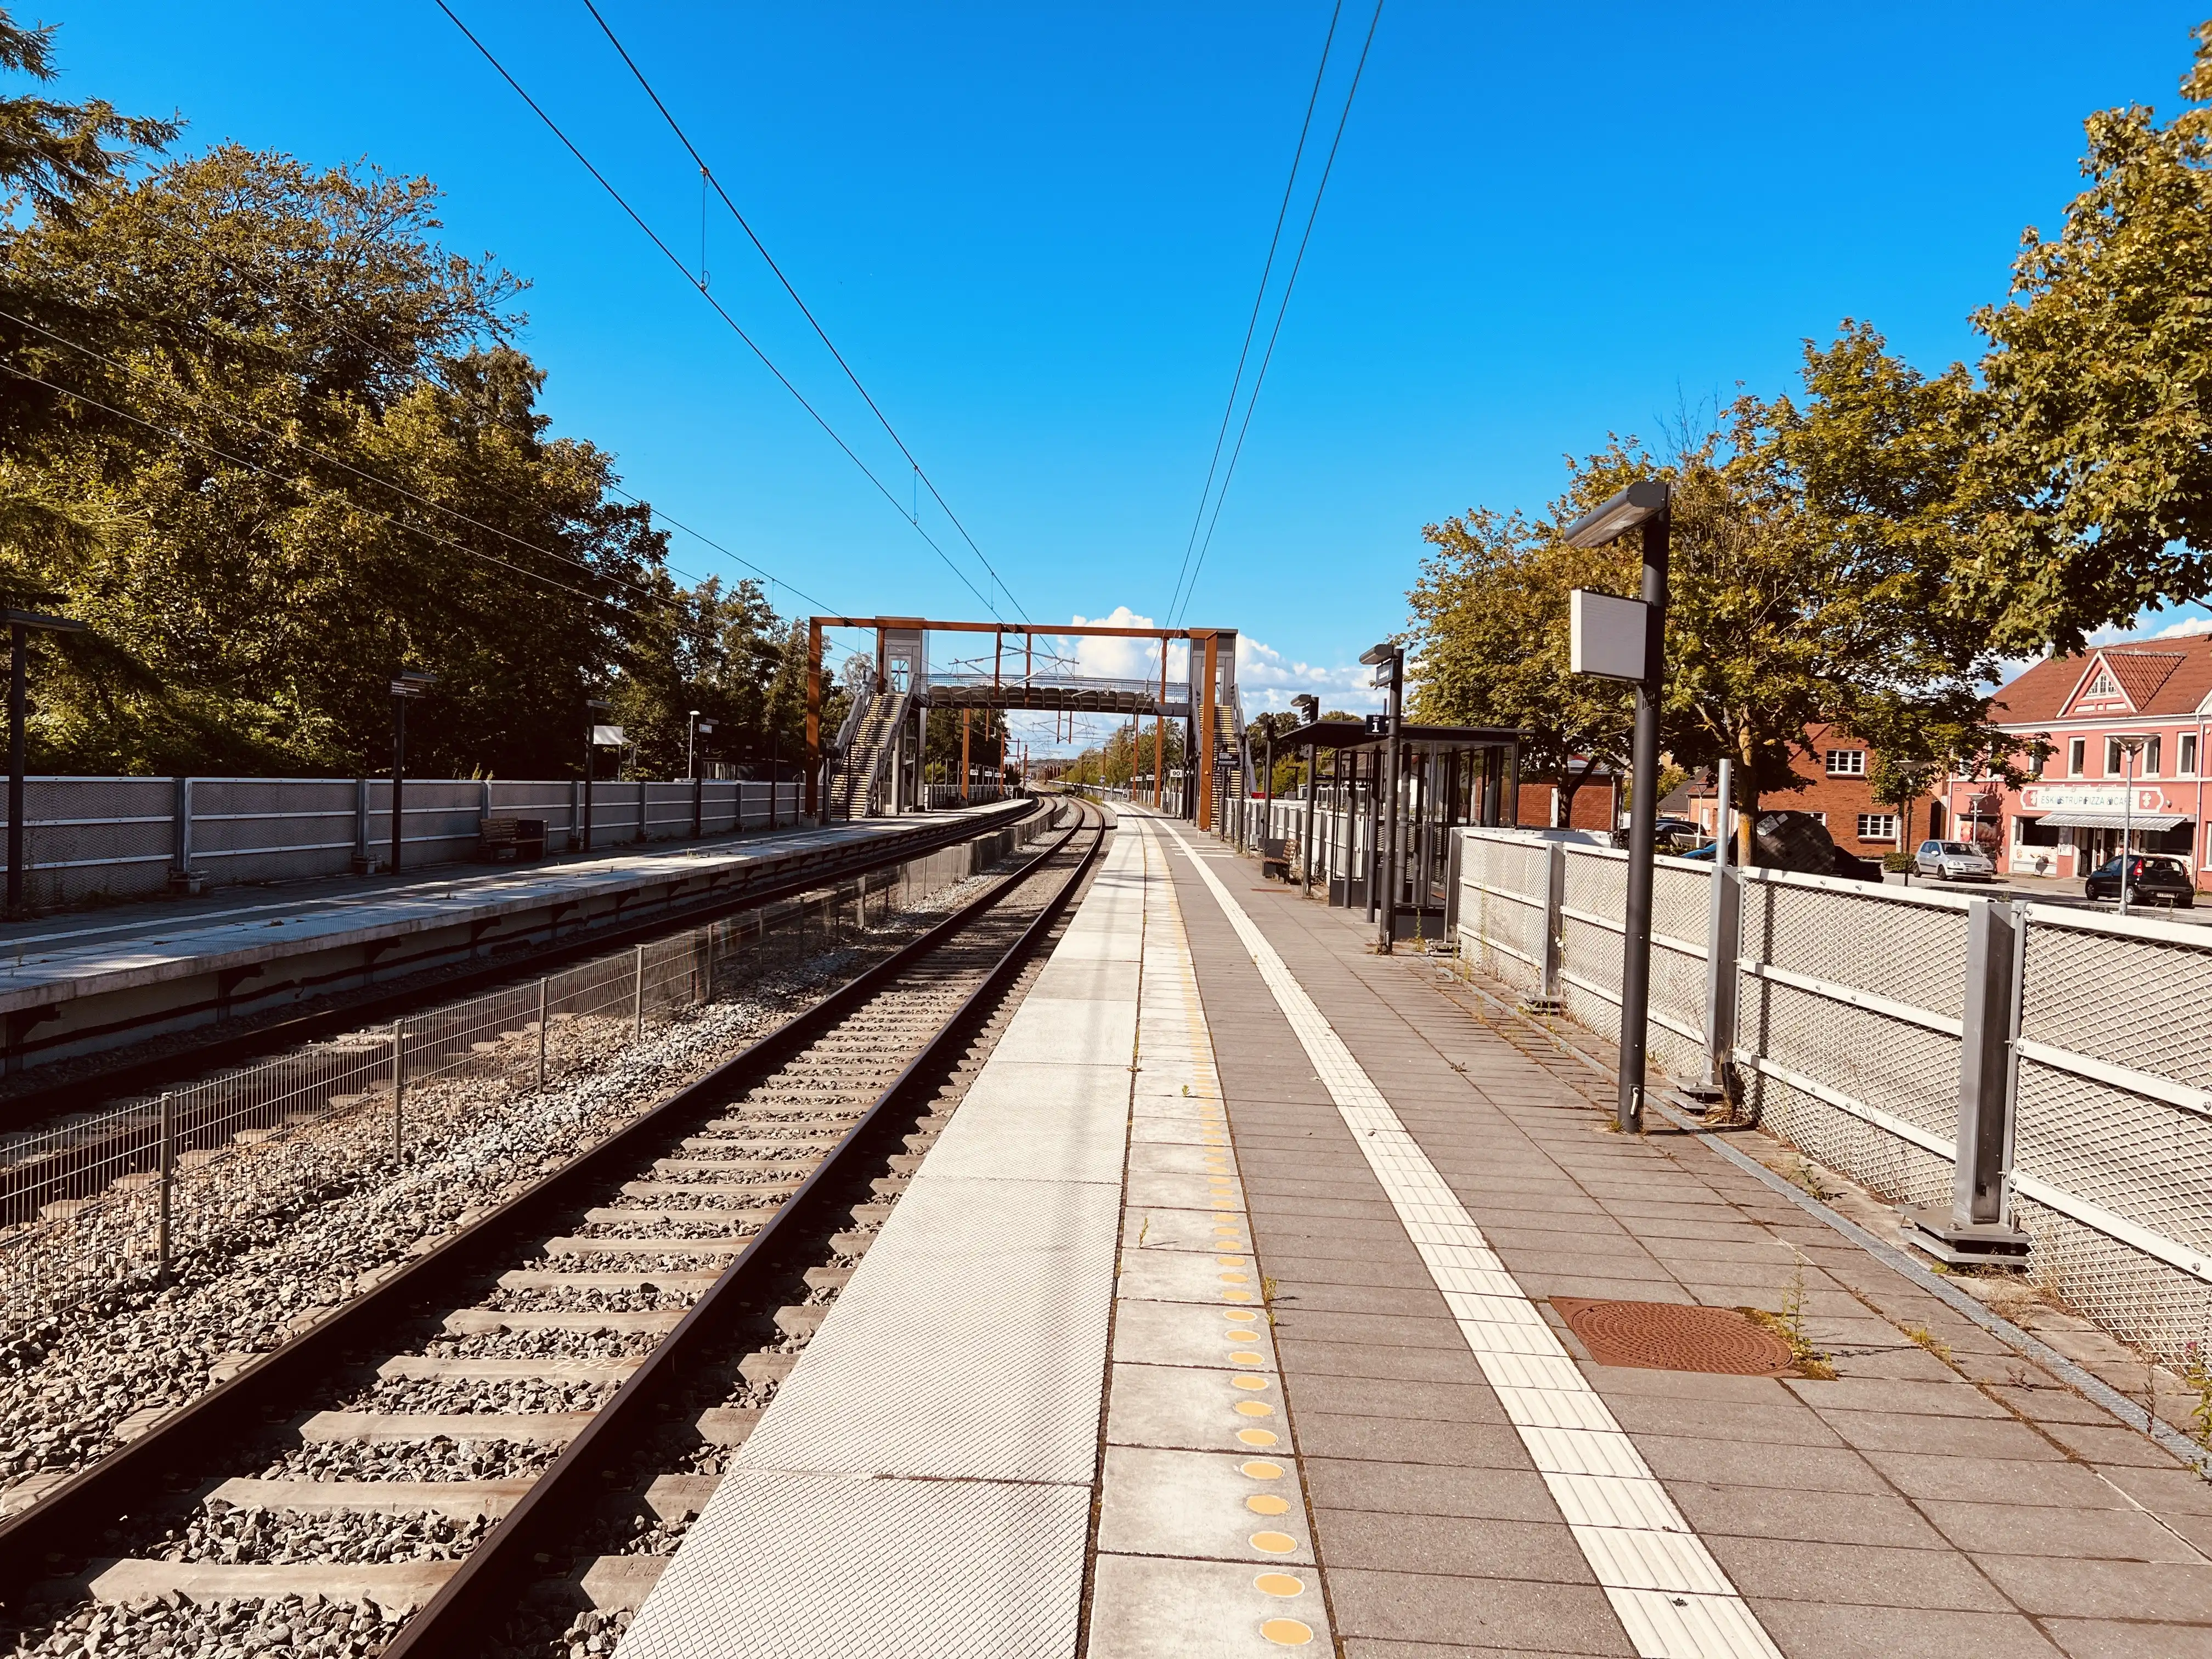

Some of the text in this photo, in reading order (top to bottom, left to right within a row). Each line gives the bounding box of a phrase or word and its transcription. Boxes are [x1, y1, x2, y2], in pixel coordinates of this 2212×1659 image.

[1372, 722, 1379, 732] 1
[2041, 795, 2083, 805] ESKILSTRUP
[2084, 796, 2104, 805] PIZZA
